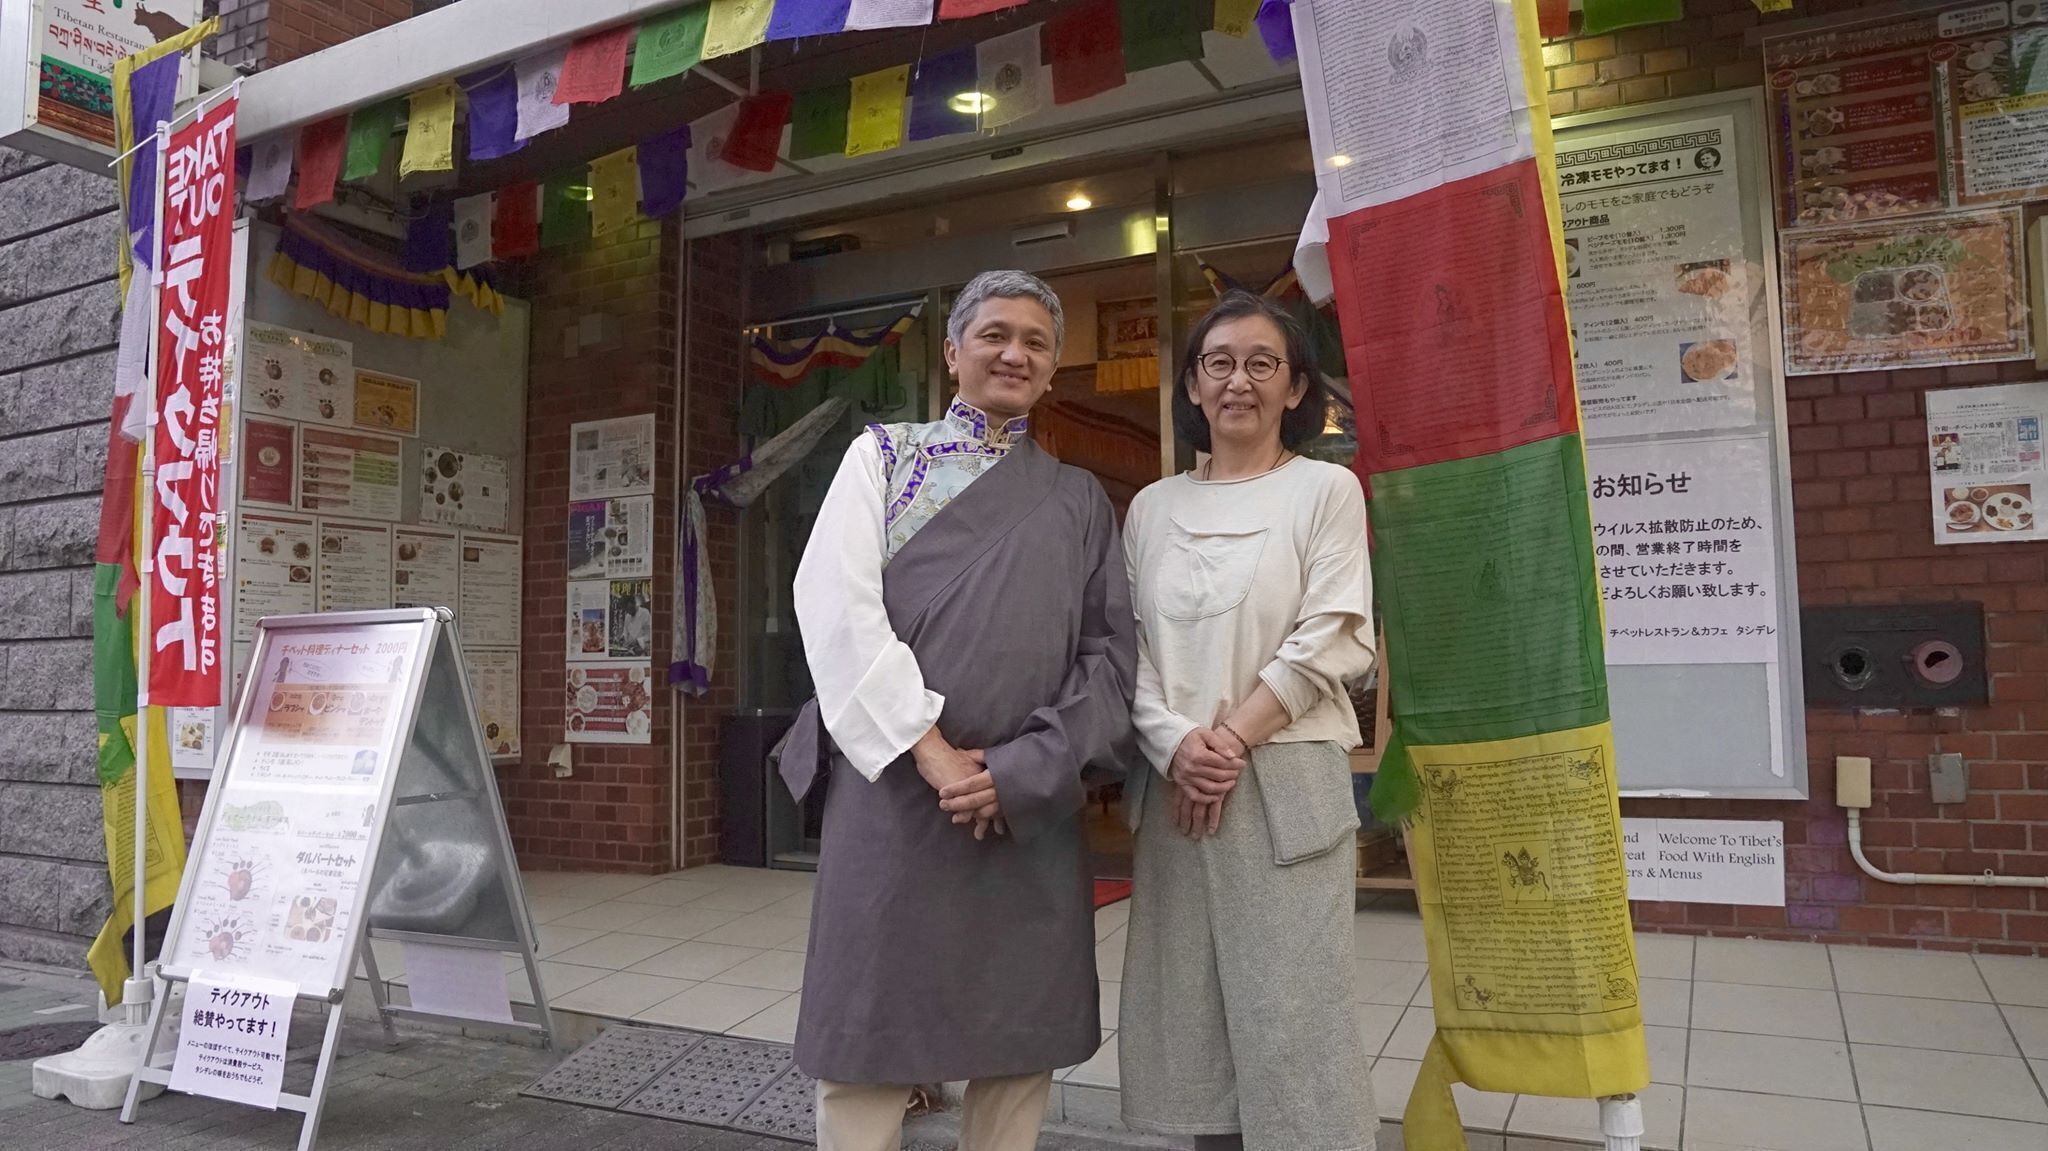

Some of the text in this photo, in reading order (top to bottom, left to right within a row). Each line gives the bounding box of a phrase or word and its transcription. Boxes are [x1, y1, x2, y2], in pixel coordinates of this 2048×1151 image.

[54, 6, 94, 31] Tibetan
[98, 25, 148, 50] Restauran
[1560, 157, 1682, 187] 冷凍モモやってます！
[1592, 471, 1692, 499] お知らせ
[1593, 516, 1764, 536] ウイルス拡散防止のため、
[1596, 539, 1742, 557] の間、営業終了時間を
[1600, 561, 1734, 578] させていただきます。
[1658, 832, 1717, 846] Welcome
[1720, 834, 1737, 847] To
[1659, 850, 1688, 862] Food
[1692, 851, 1724, 864] With
[1729, 853, 1775, 868] English
[1646, 868, 1656, 878] &
[1659, 868, 1703, 880] Menus
[210, 987, 270, 1011] テイクアウト
[192, 1009, 277, 1038] 絶賛やってます！
